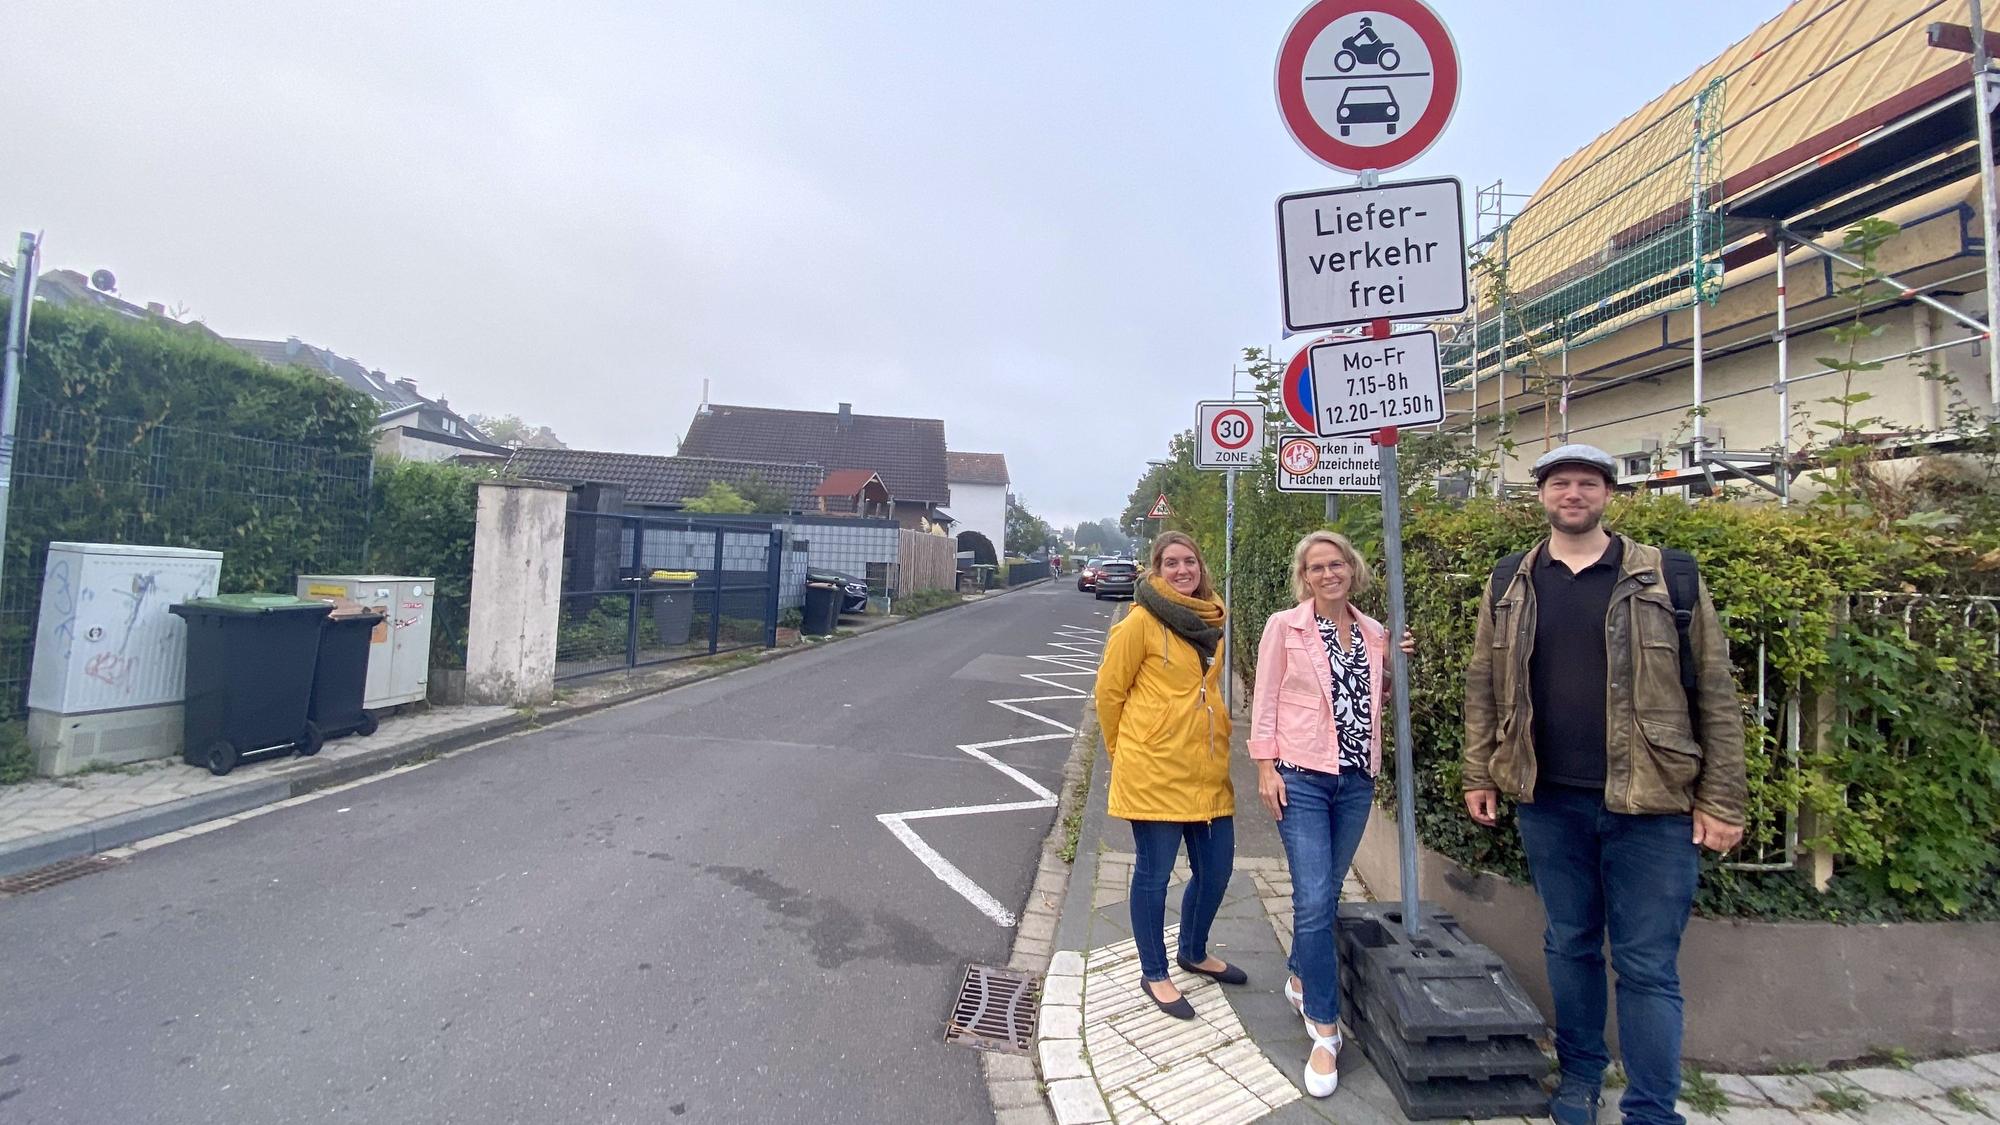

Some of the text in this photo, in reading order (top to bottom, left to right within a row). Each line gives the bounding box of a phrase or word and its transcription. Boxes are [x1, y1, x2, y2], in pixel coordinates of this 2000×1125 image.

[1315, 202, 1427, 236] Liefer-
[1309, 237, 1438, 275] verkehr
[1349, 276, 1405, 308] frei
[1343, 347, 1405, 371] Mo-Fr
[1220, 421, 1244, 438] 30
[1215, 452, 1247, 462] ZONE
[1316, 442, 1364, 455] arken in
[1315, 458, 1380, 470] nzeichnete
[1339, 473, 1381, 486] erlaubt
